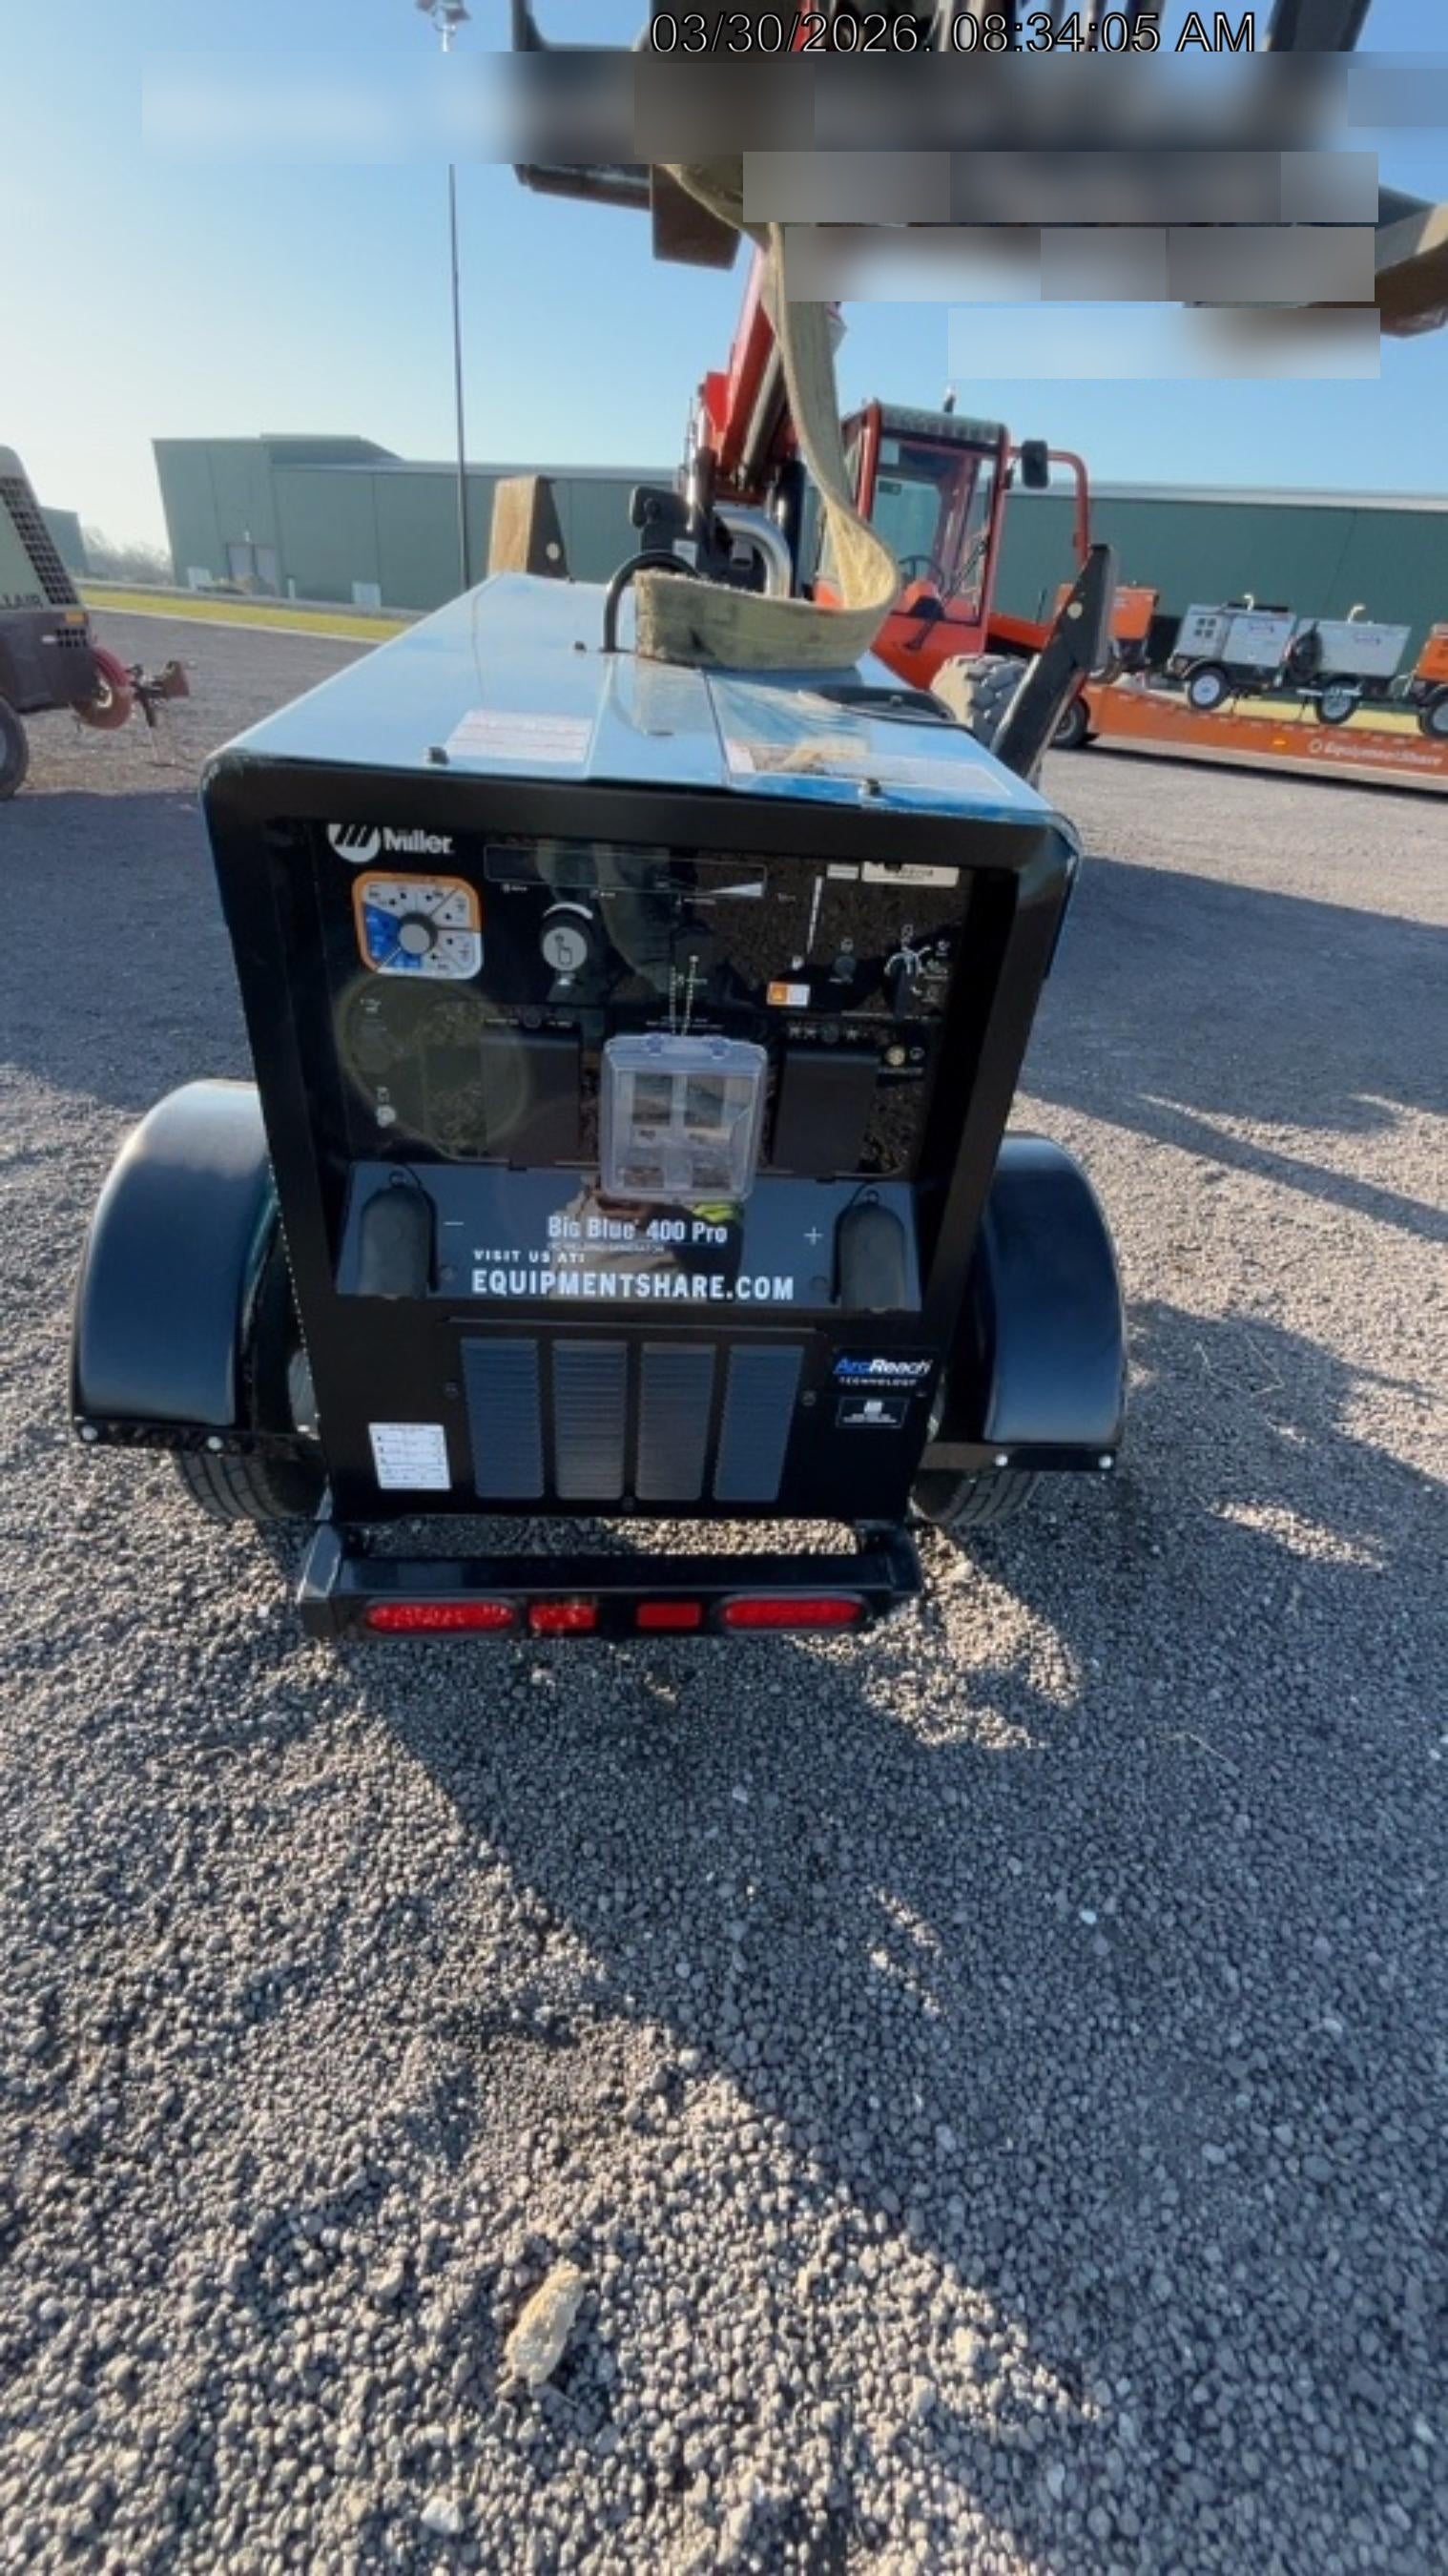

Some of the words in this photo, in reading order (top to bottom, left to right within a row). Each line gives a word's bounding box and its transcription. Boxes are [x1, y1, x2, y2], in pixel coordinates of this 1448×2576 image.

[383, 826, 455, 855] Miller
[548, 1215, 581, 1238] Big
[588, 1216, 636, 1240] Blue
[646, 1219, 686, 1241] 400
[692, 1220, 728, 1244] Pro
[473, 1249, 522, 1263] VISIT
[528, 1250, 551, 1263] US
[471, 1268, 795, 1301] EQUIPMENTSHARE.COM
[834, 1358, 934, 1376] ArcReach
